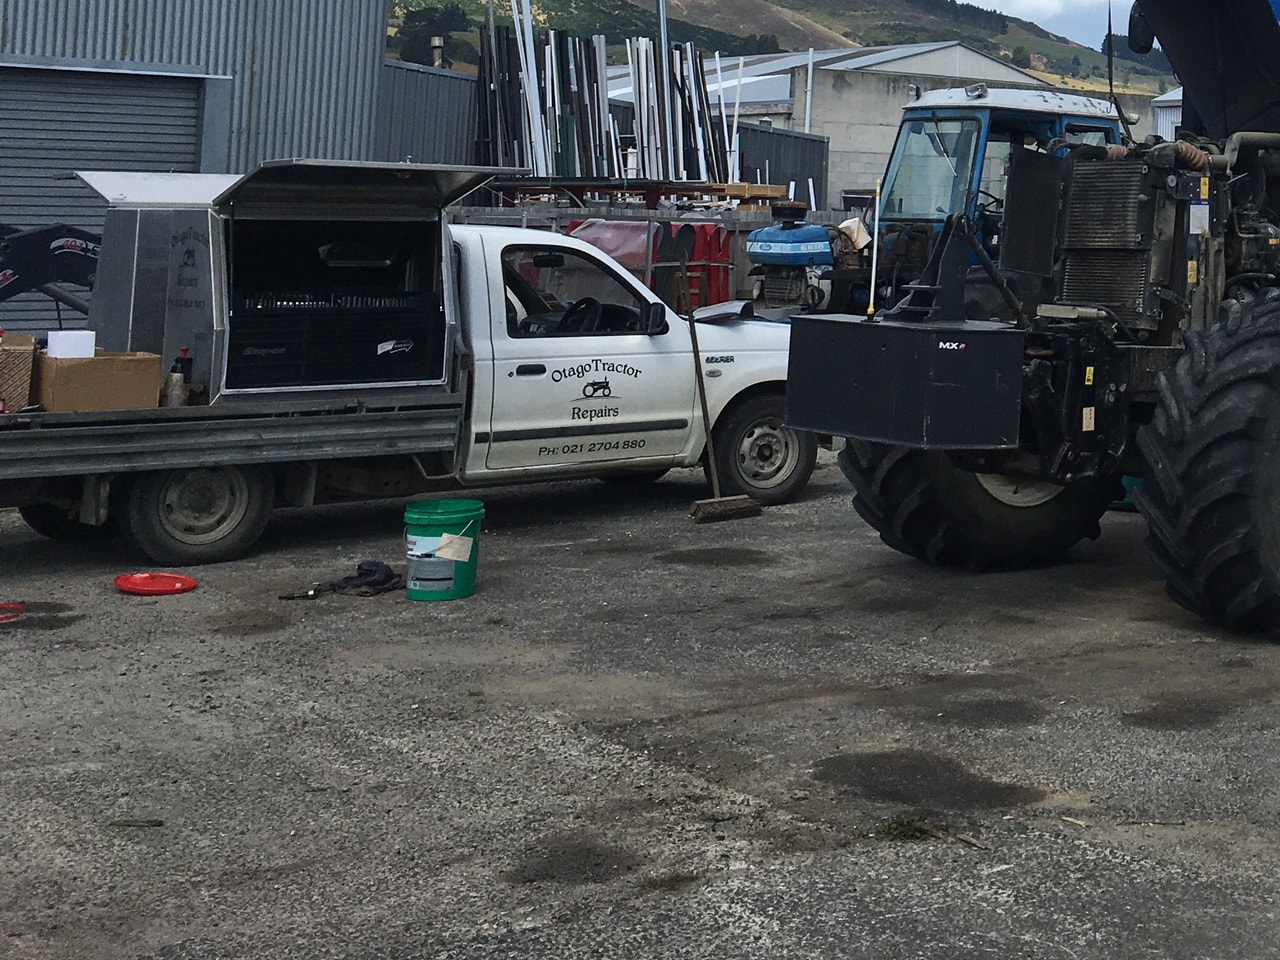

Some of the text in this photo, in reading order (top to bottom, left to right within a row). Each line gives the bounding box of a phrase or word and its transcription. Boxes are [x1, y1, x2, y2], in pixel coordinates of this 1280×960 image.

[938, 341, 959, 350] MX
[571, 406, 619, 421] Repairs
[562, 444, 584, 454] 021
[588, 442, 620, 452] 2704
[622, 439, 646, 450] 880
